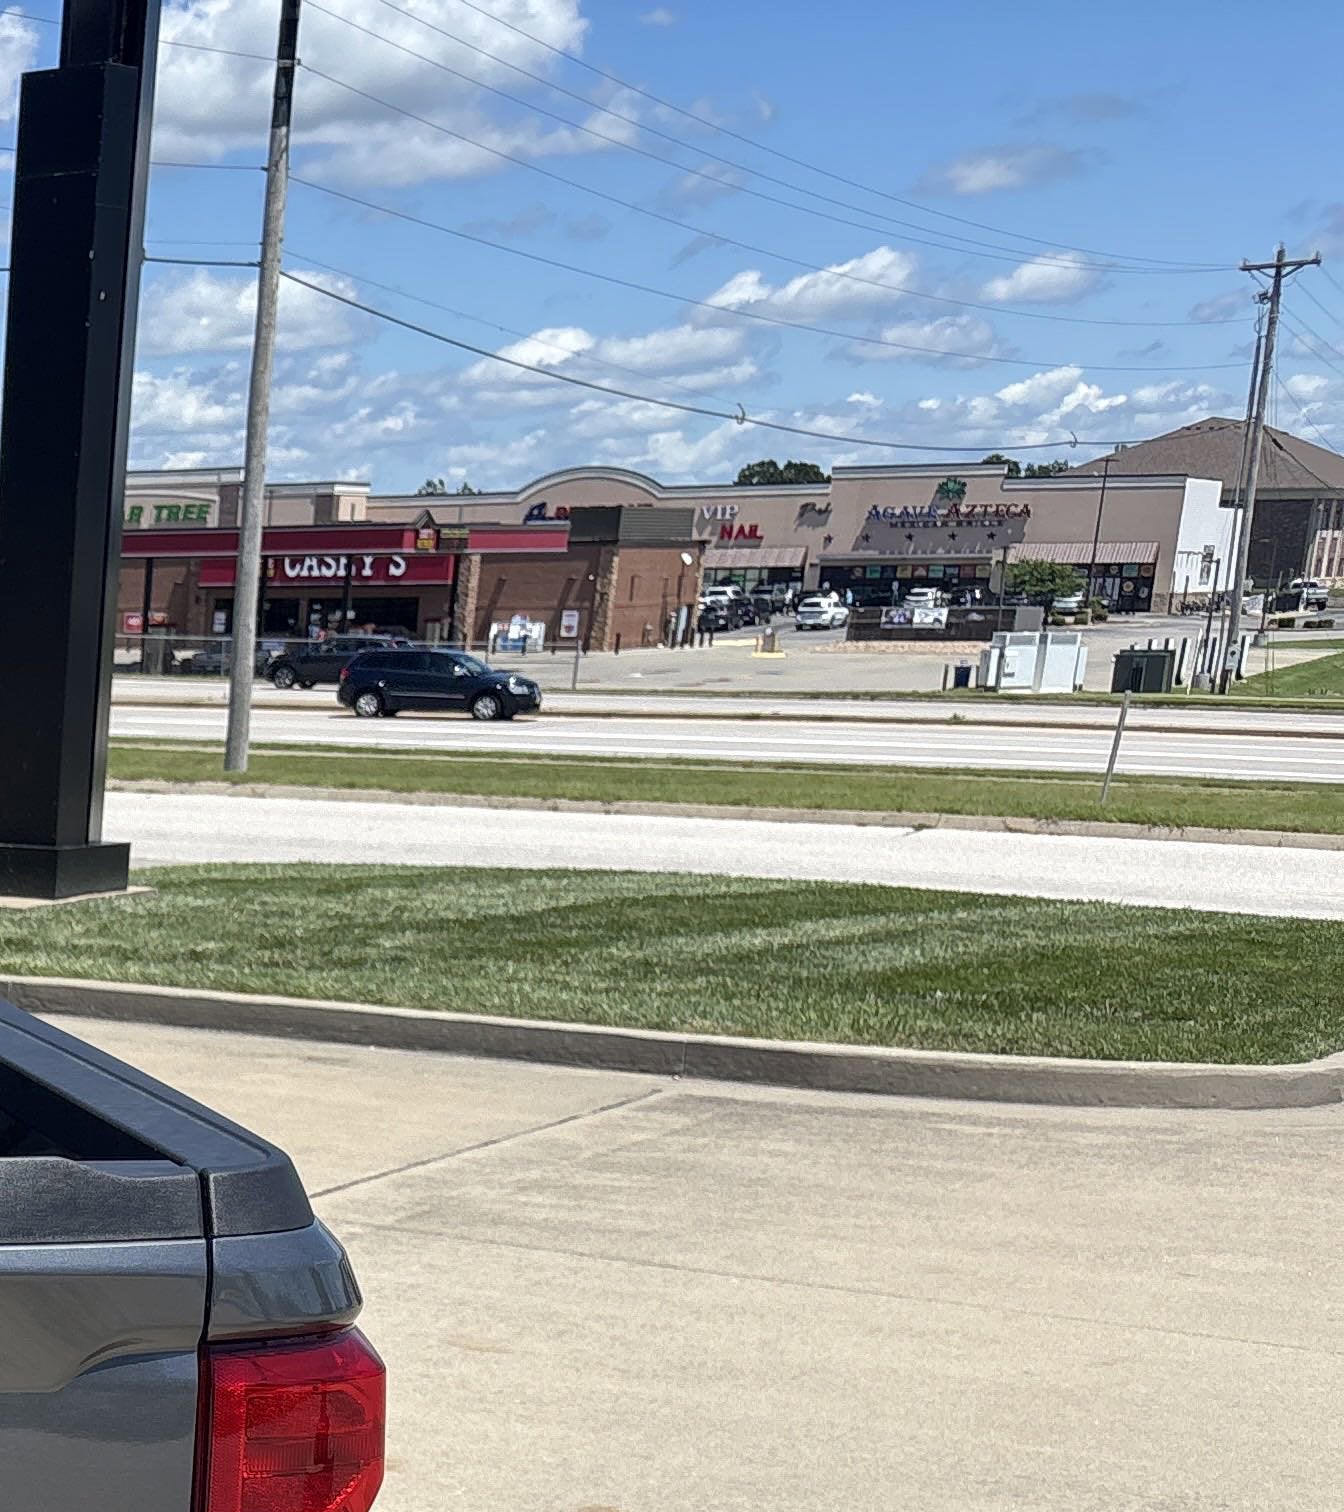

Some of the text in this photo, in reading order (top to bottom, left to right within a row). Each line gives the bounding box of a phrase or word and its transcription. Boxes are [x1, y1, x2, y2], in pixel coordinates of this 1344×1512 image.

[153, 504, 210, 523] TREE
[702, 503, 739, 520] VIP
[867, 503, 1031, 521] AGAVE AZTECA
[283, 554, 407, 578] CASYS
